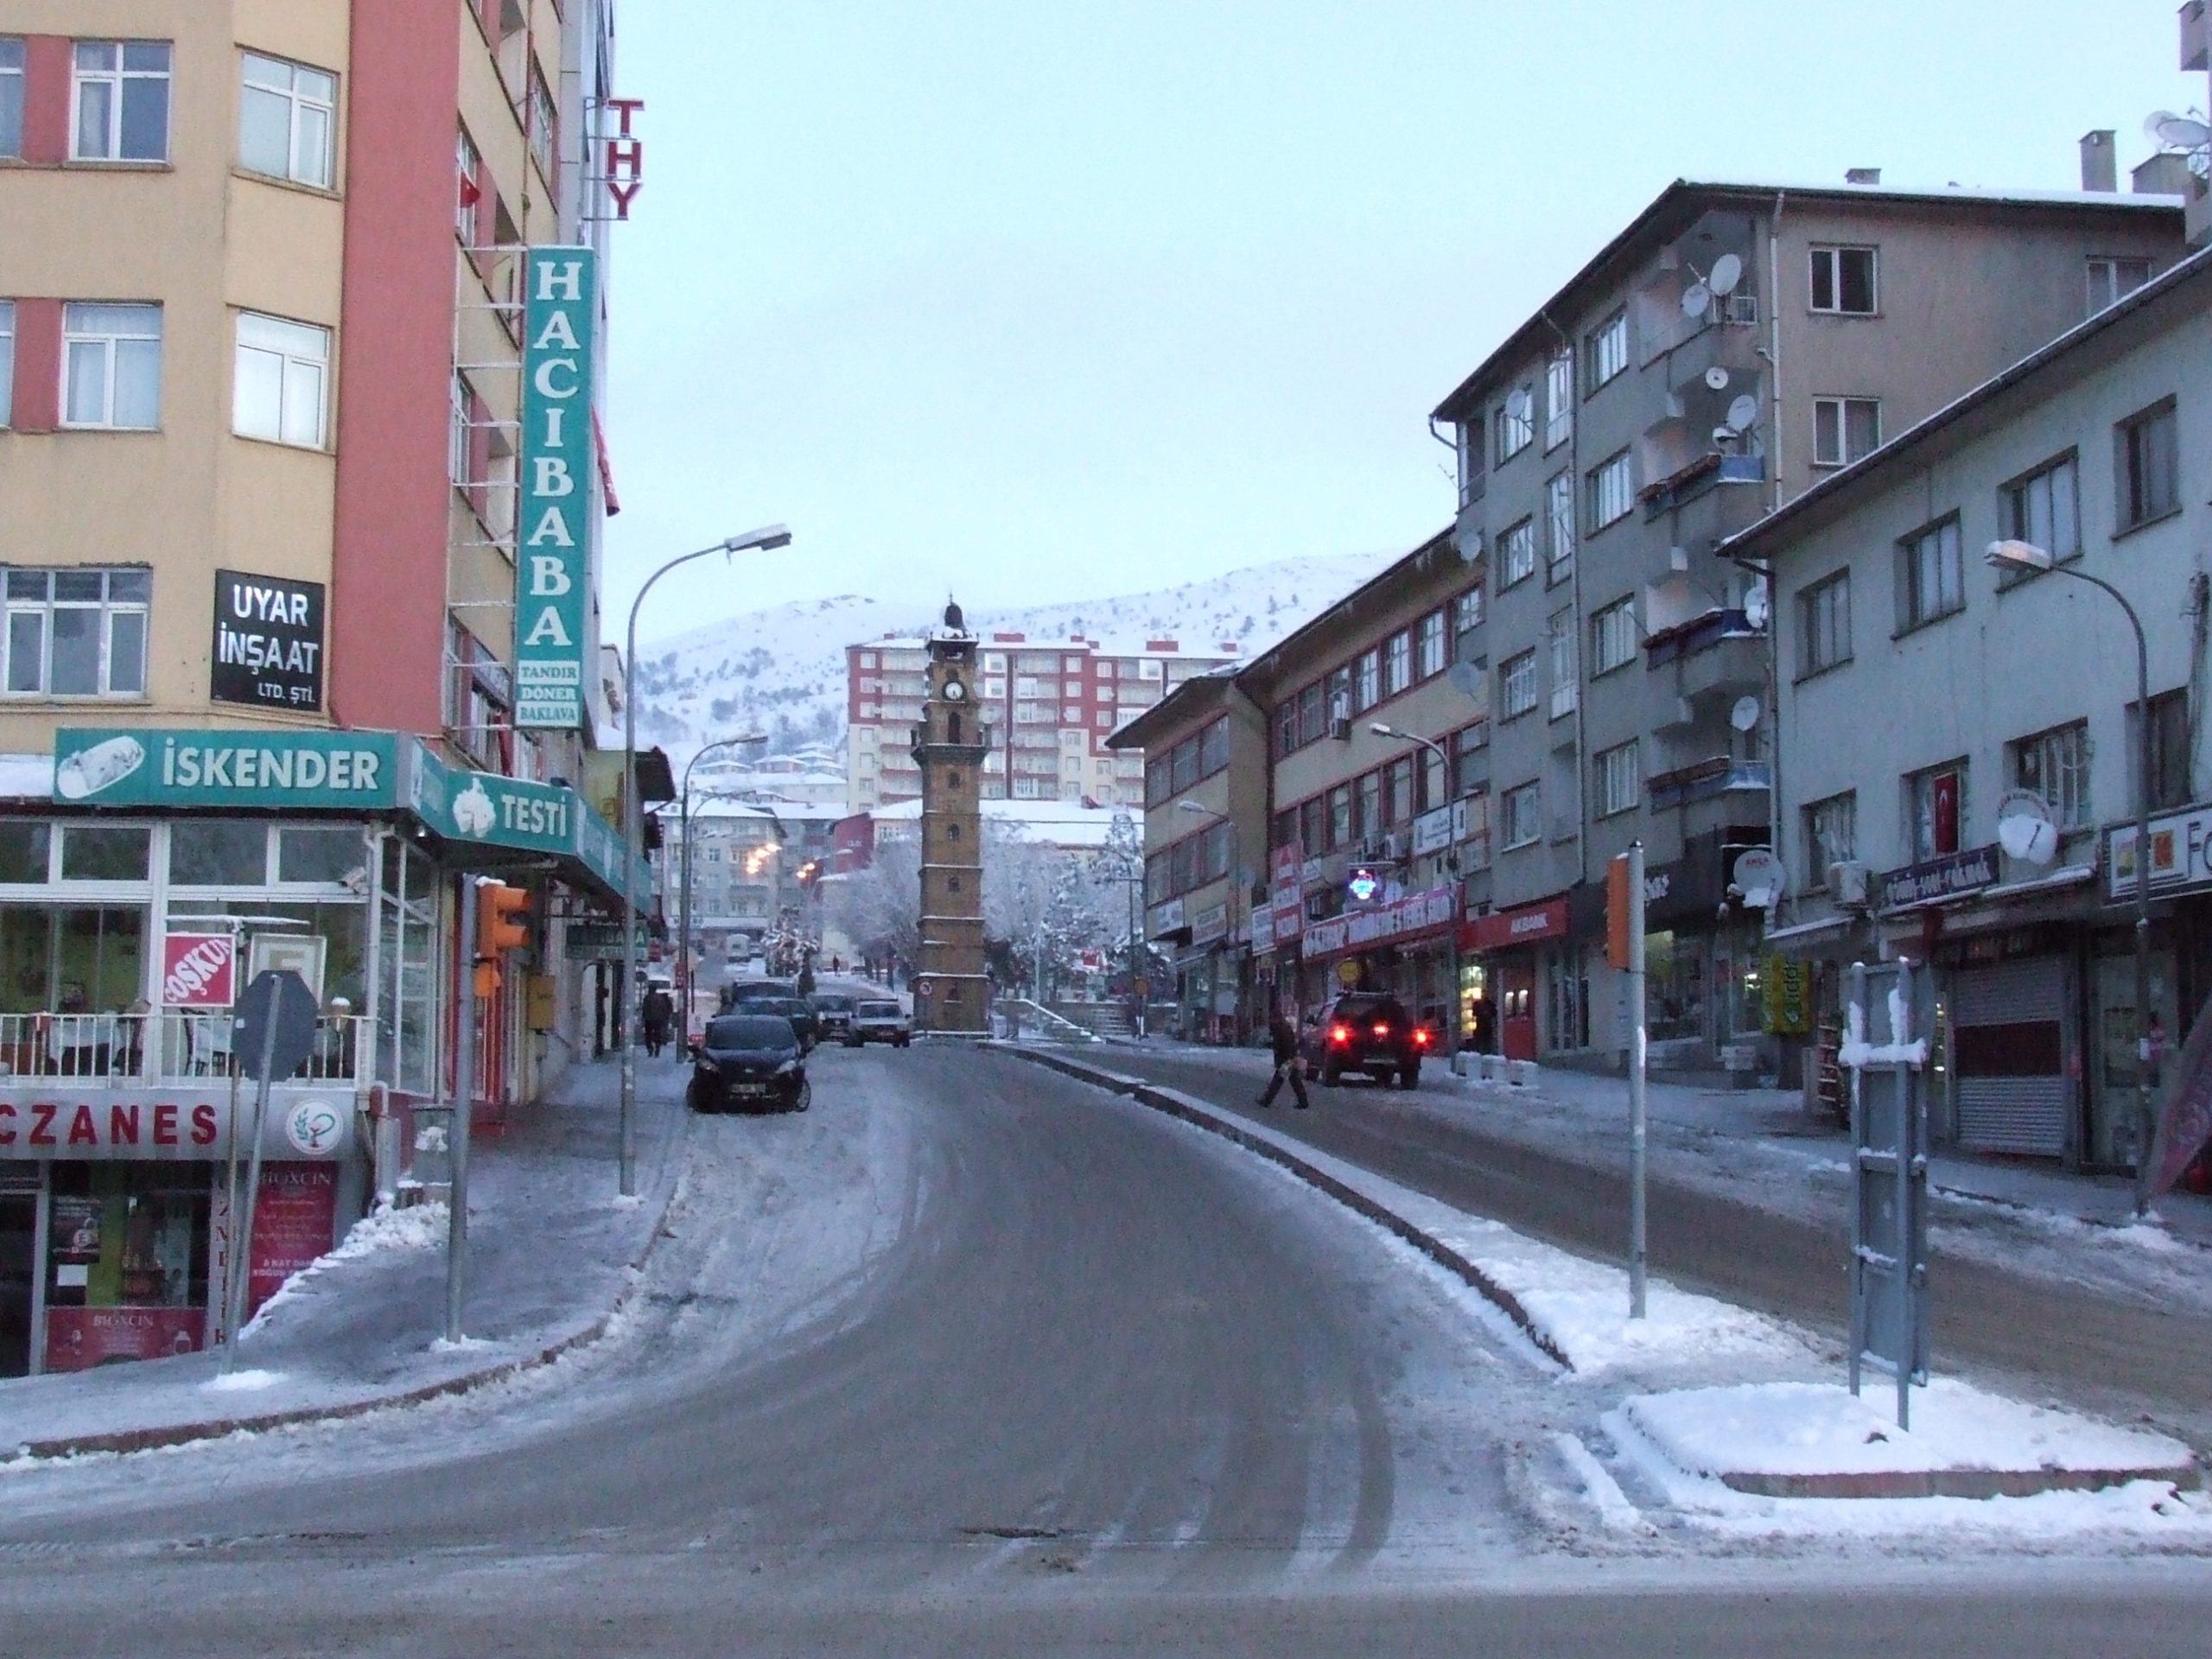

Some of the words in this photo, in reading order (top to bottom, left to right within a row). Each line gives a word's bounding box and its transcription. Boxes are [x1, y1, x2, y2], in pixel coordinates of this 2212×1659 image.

[607, 99, 645, 221] THY
[524, 260, 582, 648] HACIBABA
[233, 584, 308, 626] UYAR
[219, 621, 319, 676] İNŞAAT
[521, 666, 576, 678] TANDIR
[258, 682, 286, 700] LTD.
[520, 707, 576, 721] BAKLAVA
[162, 738, 380, 791] İSKENDER
[499, 794, 567, 837] TESTİ
[165, 938, 231, 1002] COŞKUN
